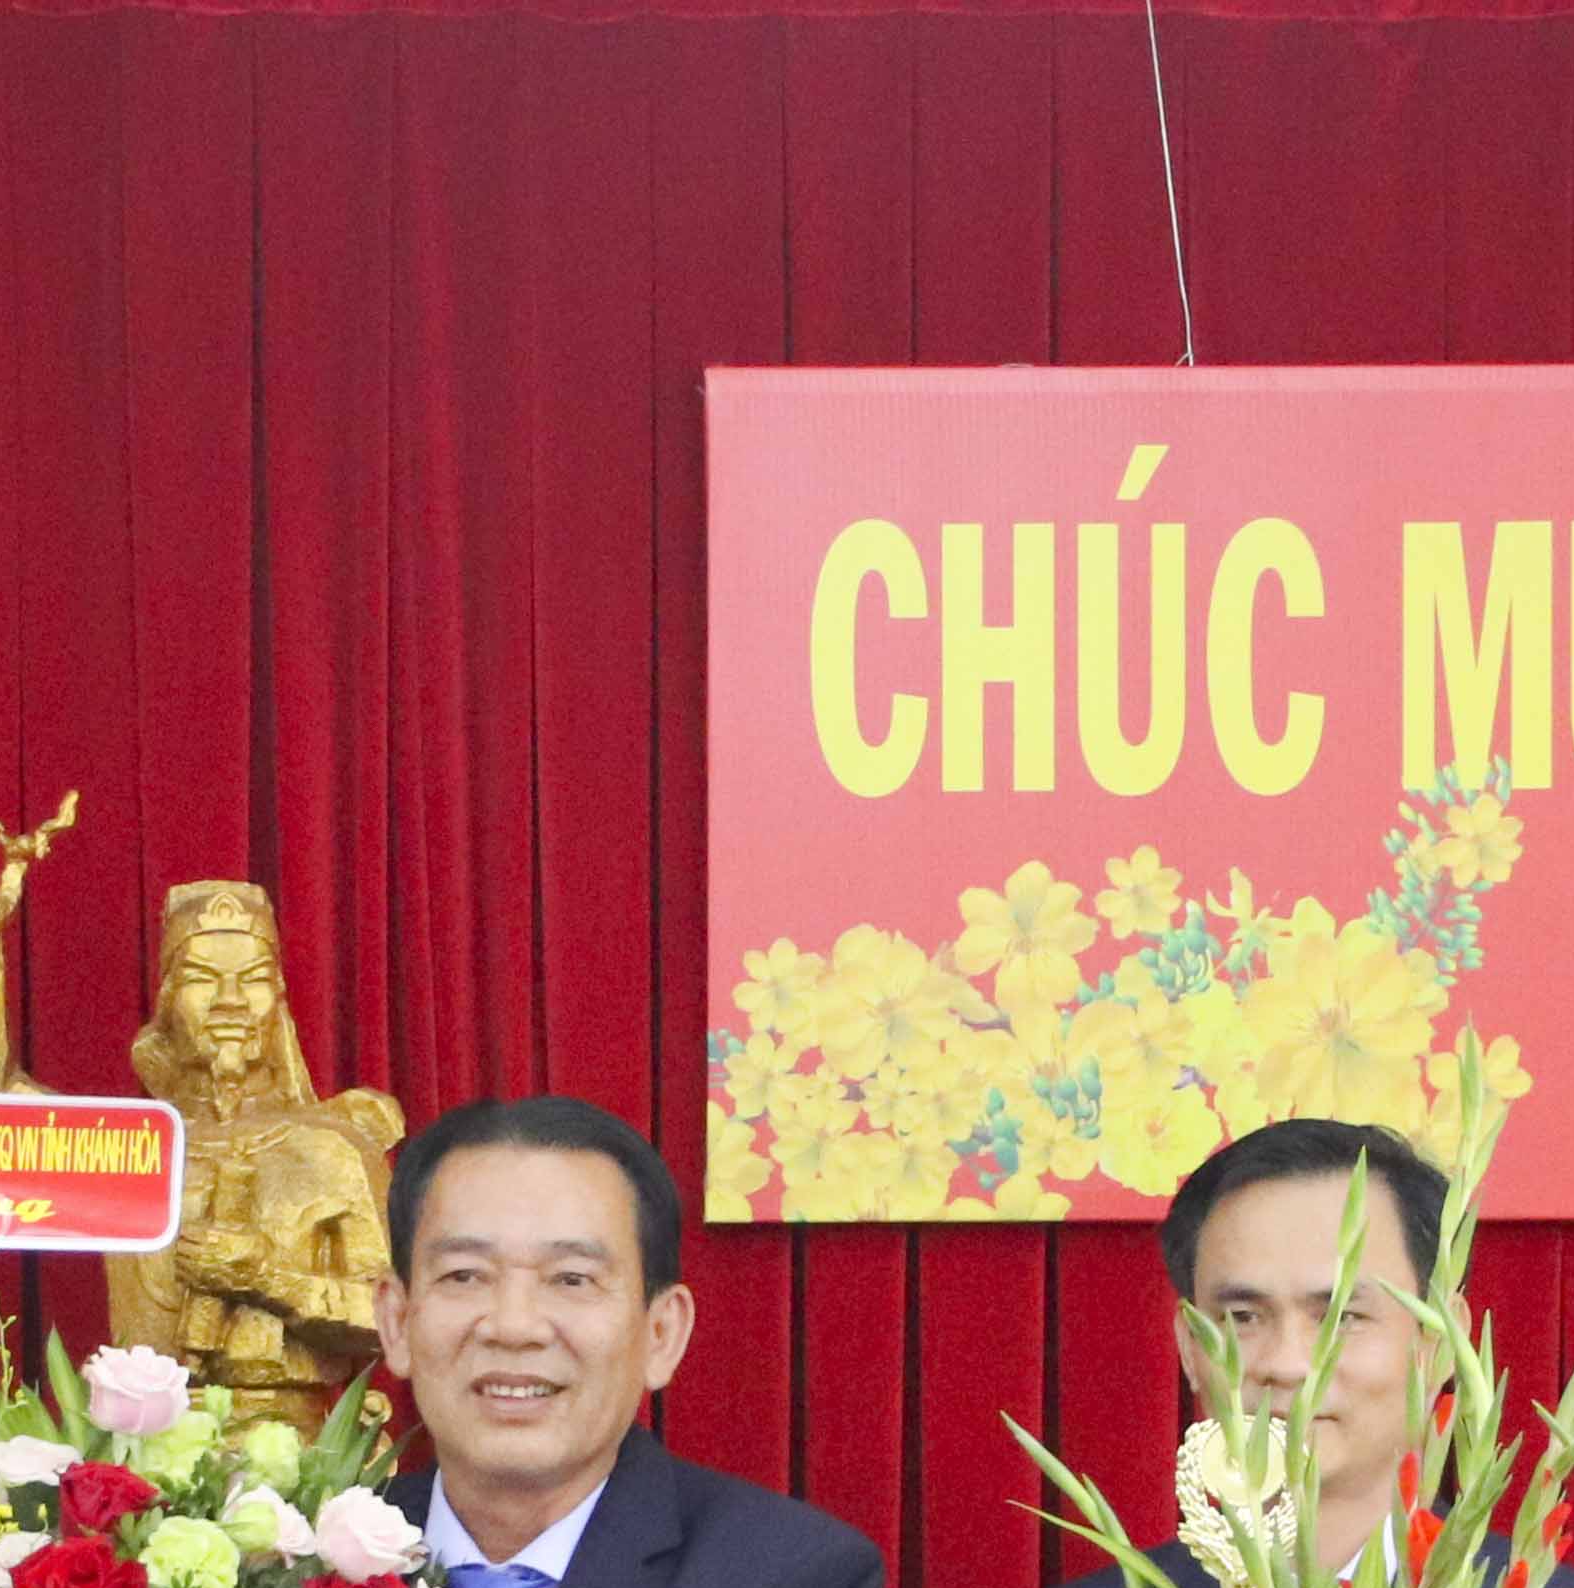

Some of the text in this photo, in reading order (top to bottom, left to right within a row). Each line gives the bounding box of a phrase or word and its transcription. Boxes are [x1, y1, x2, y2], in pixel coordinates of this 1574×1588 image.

[810, 443, 1326, 798] CHÚC
[73, 1118, 128, 1175] KHÁNH
[128, 1118, 162, 1176] HÒA
